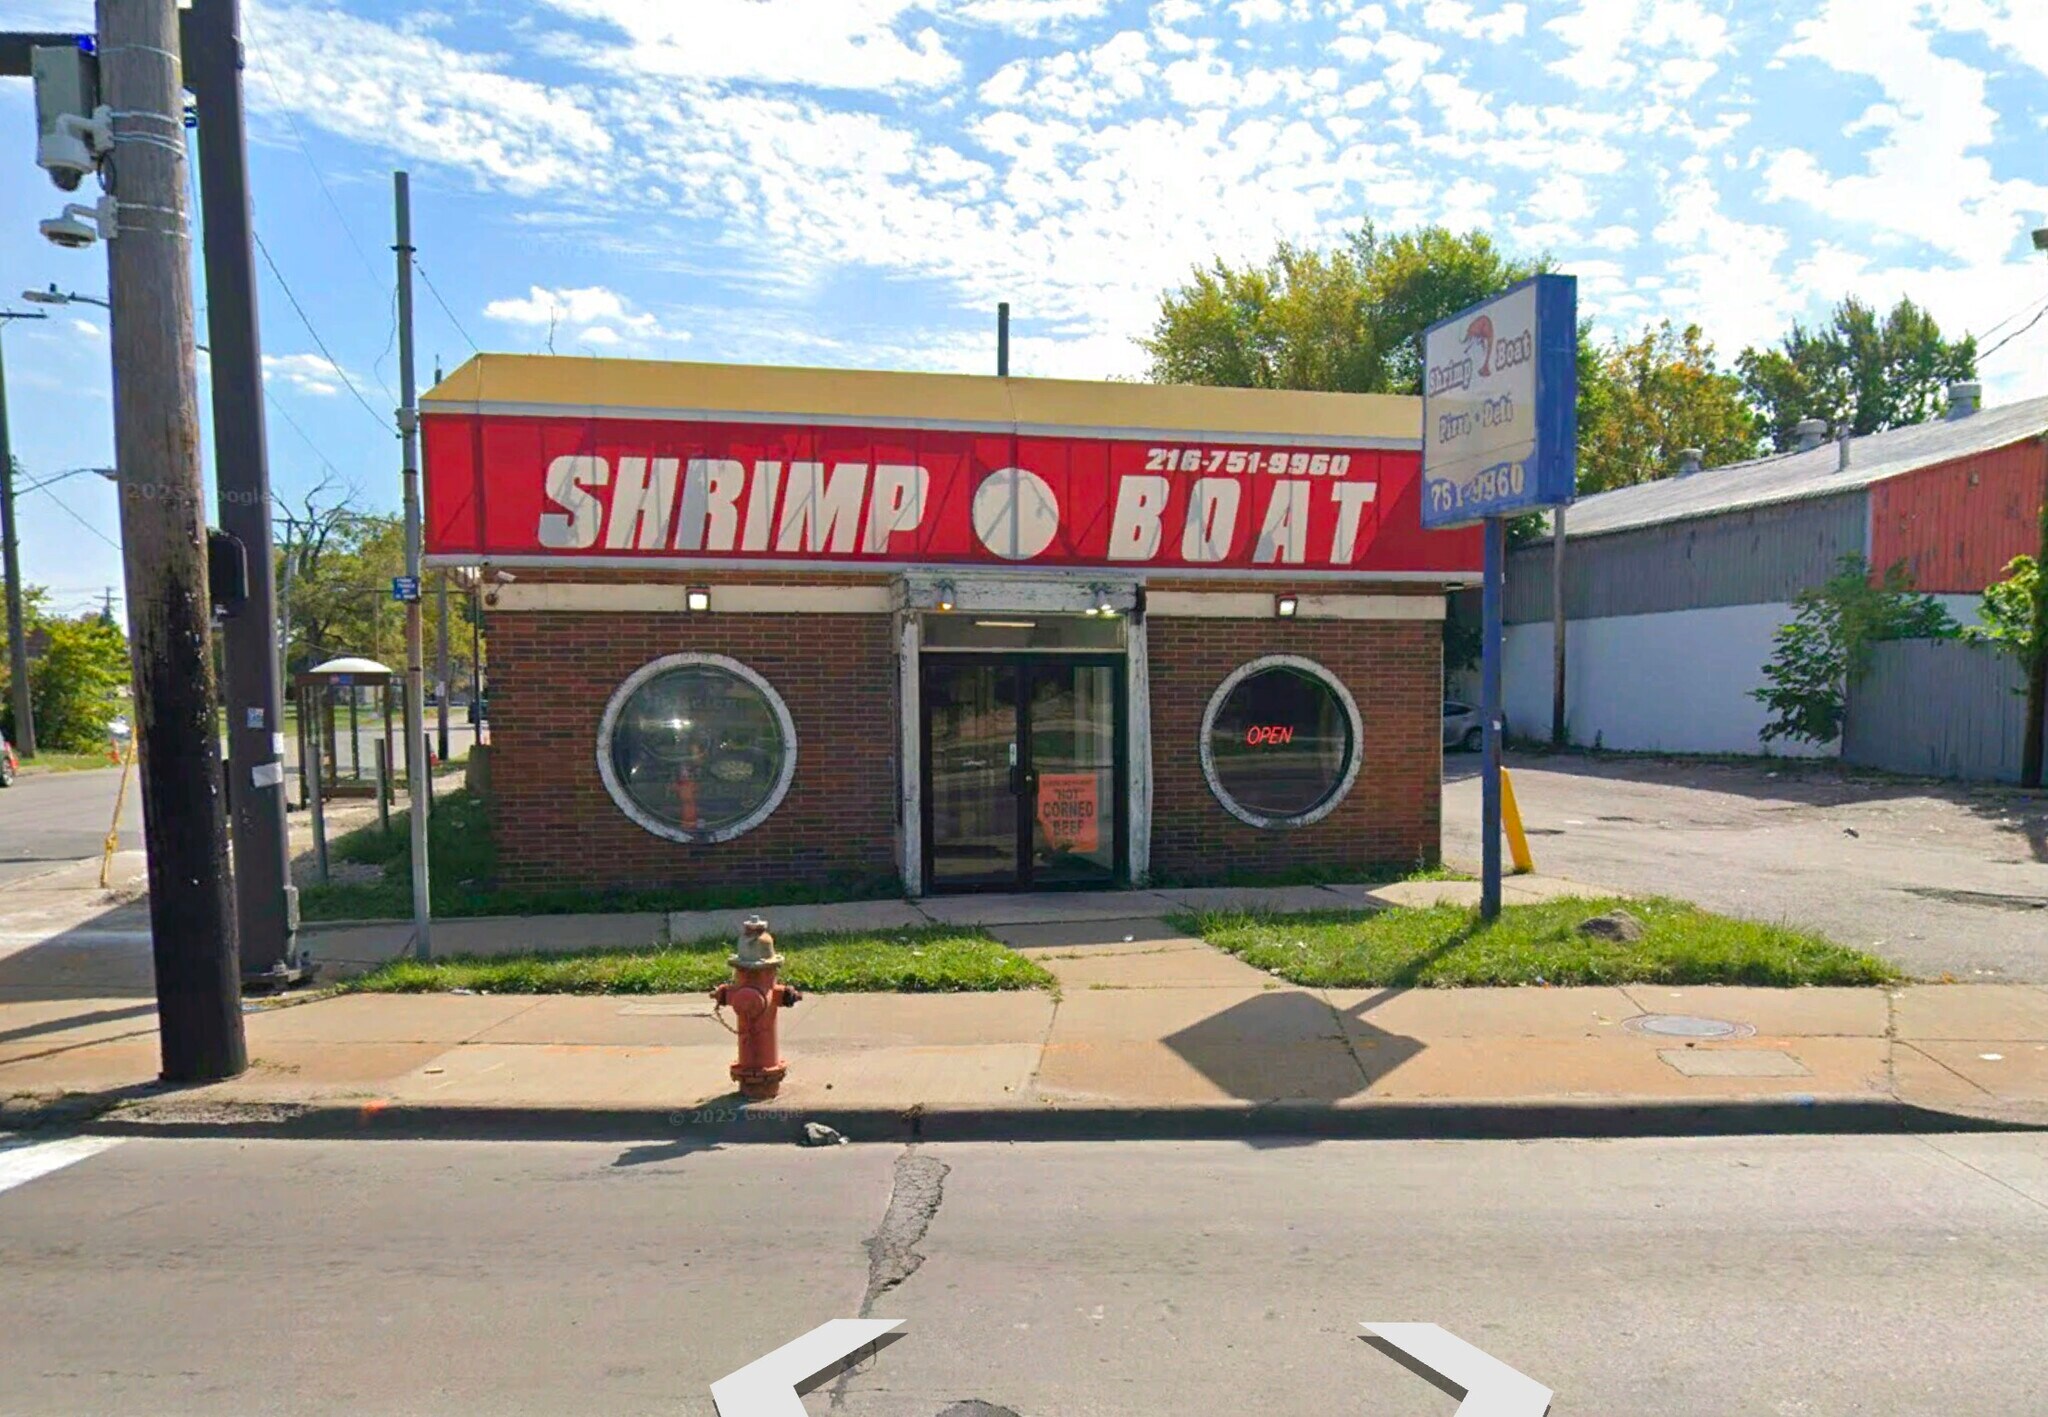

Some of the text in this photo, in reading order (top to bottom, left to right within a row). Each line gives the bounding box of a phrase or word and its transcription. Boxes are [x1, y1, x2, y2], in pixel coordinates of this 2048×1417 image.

[1495, 329, 1531, 371] Boat
[1145, 448, 1351, 476] 216-751-9960
[537, 454, 930, 554] SHRIMP
[1107, 474, 1378, 564] BOAT
[1246, 725, 1295, 745] OPEN
[1043, 801, 1093, 818] CORNED
